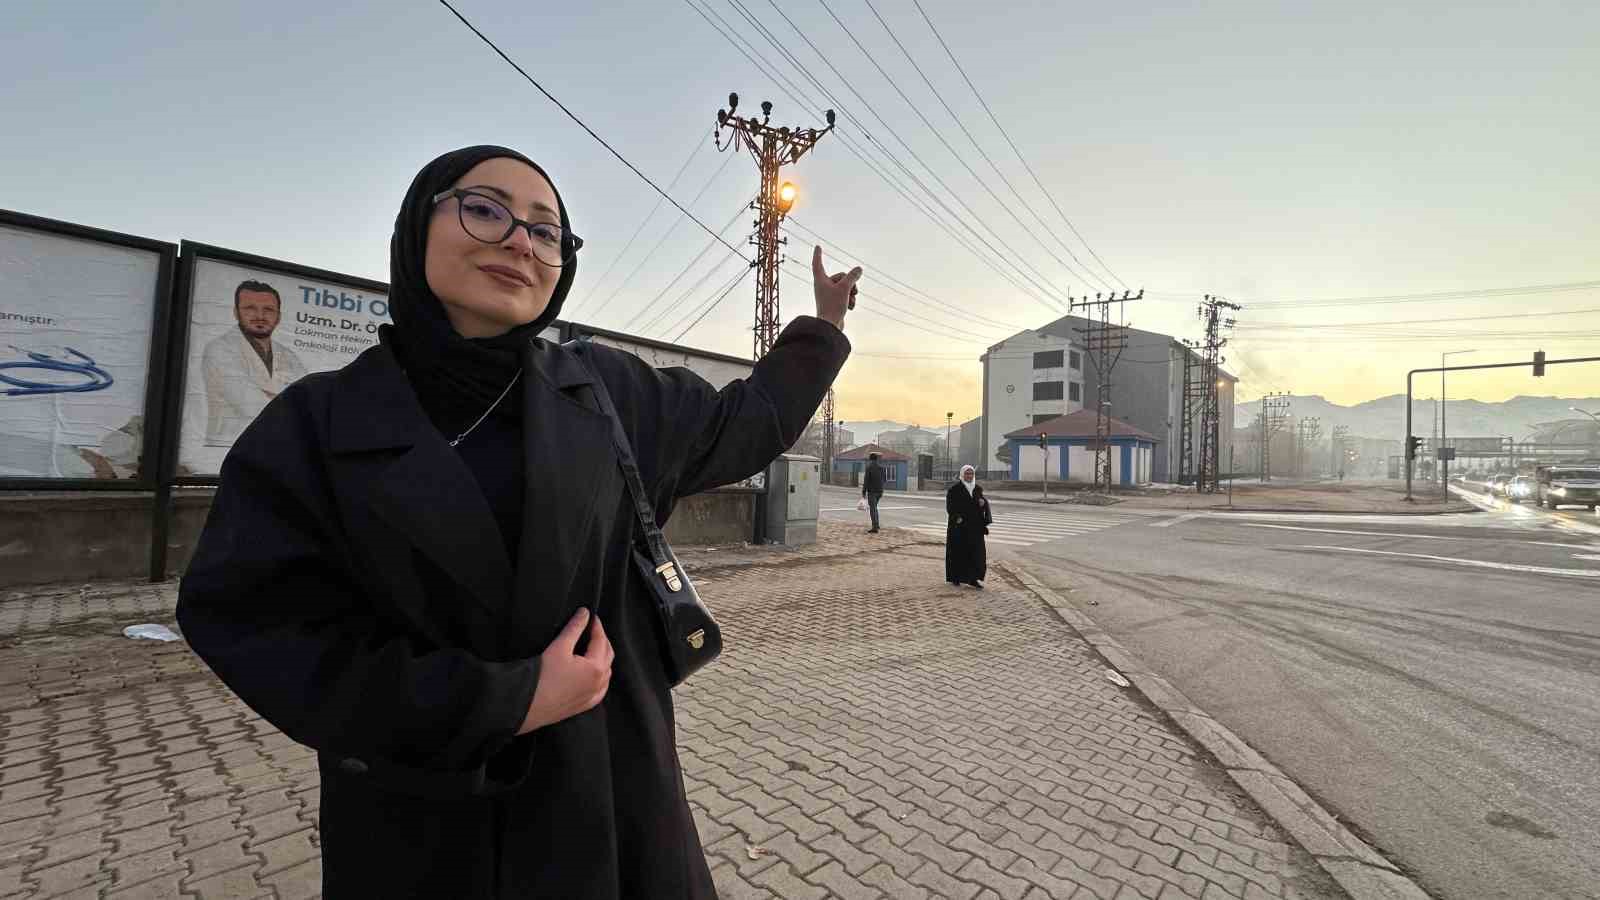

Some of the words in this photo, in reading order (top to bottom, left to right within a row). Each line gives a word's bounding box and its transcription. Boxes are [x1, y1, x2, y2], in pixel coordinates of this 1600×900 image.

[298, 286, 363, 313] Tıbbi
[296, 311, 336, 328] Uzm.
[341, 319, 361, 332] Dr.
[294, 327, 338, 340] Lokman
